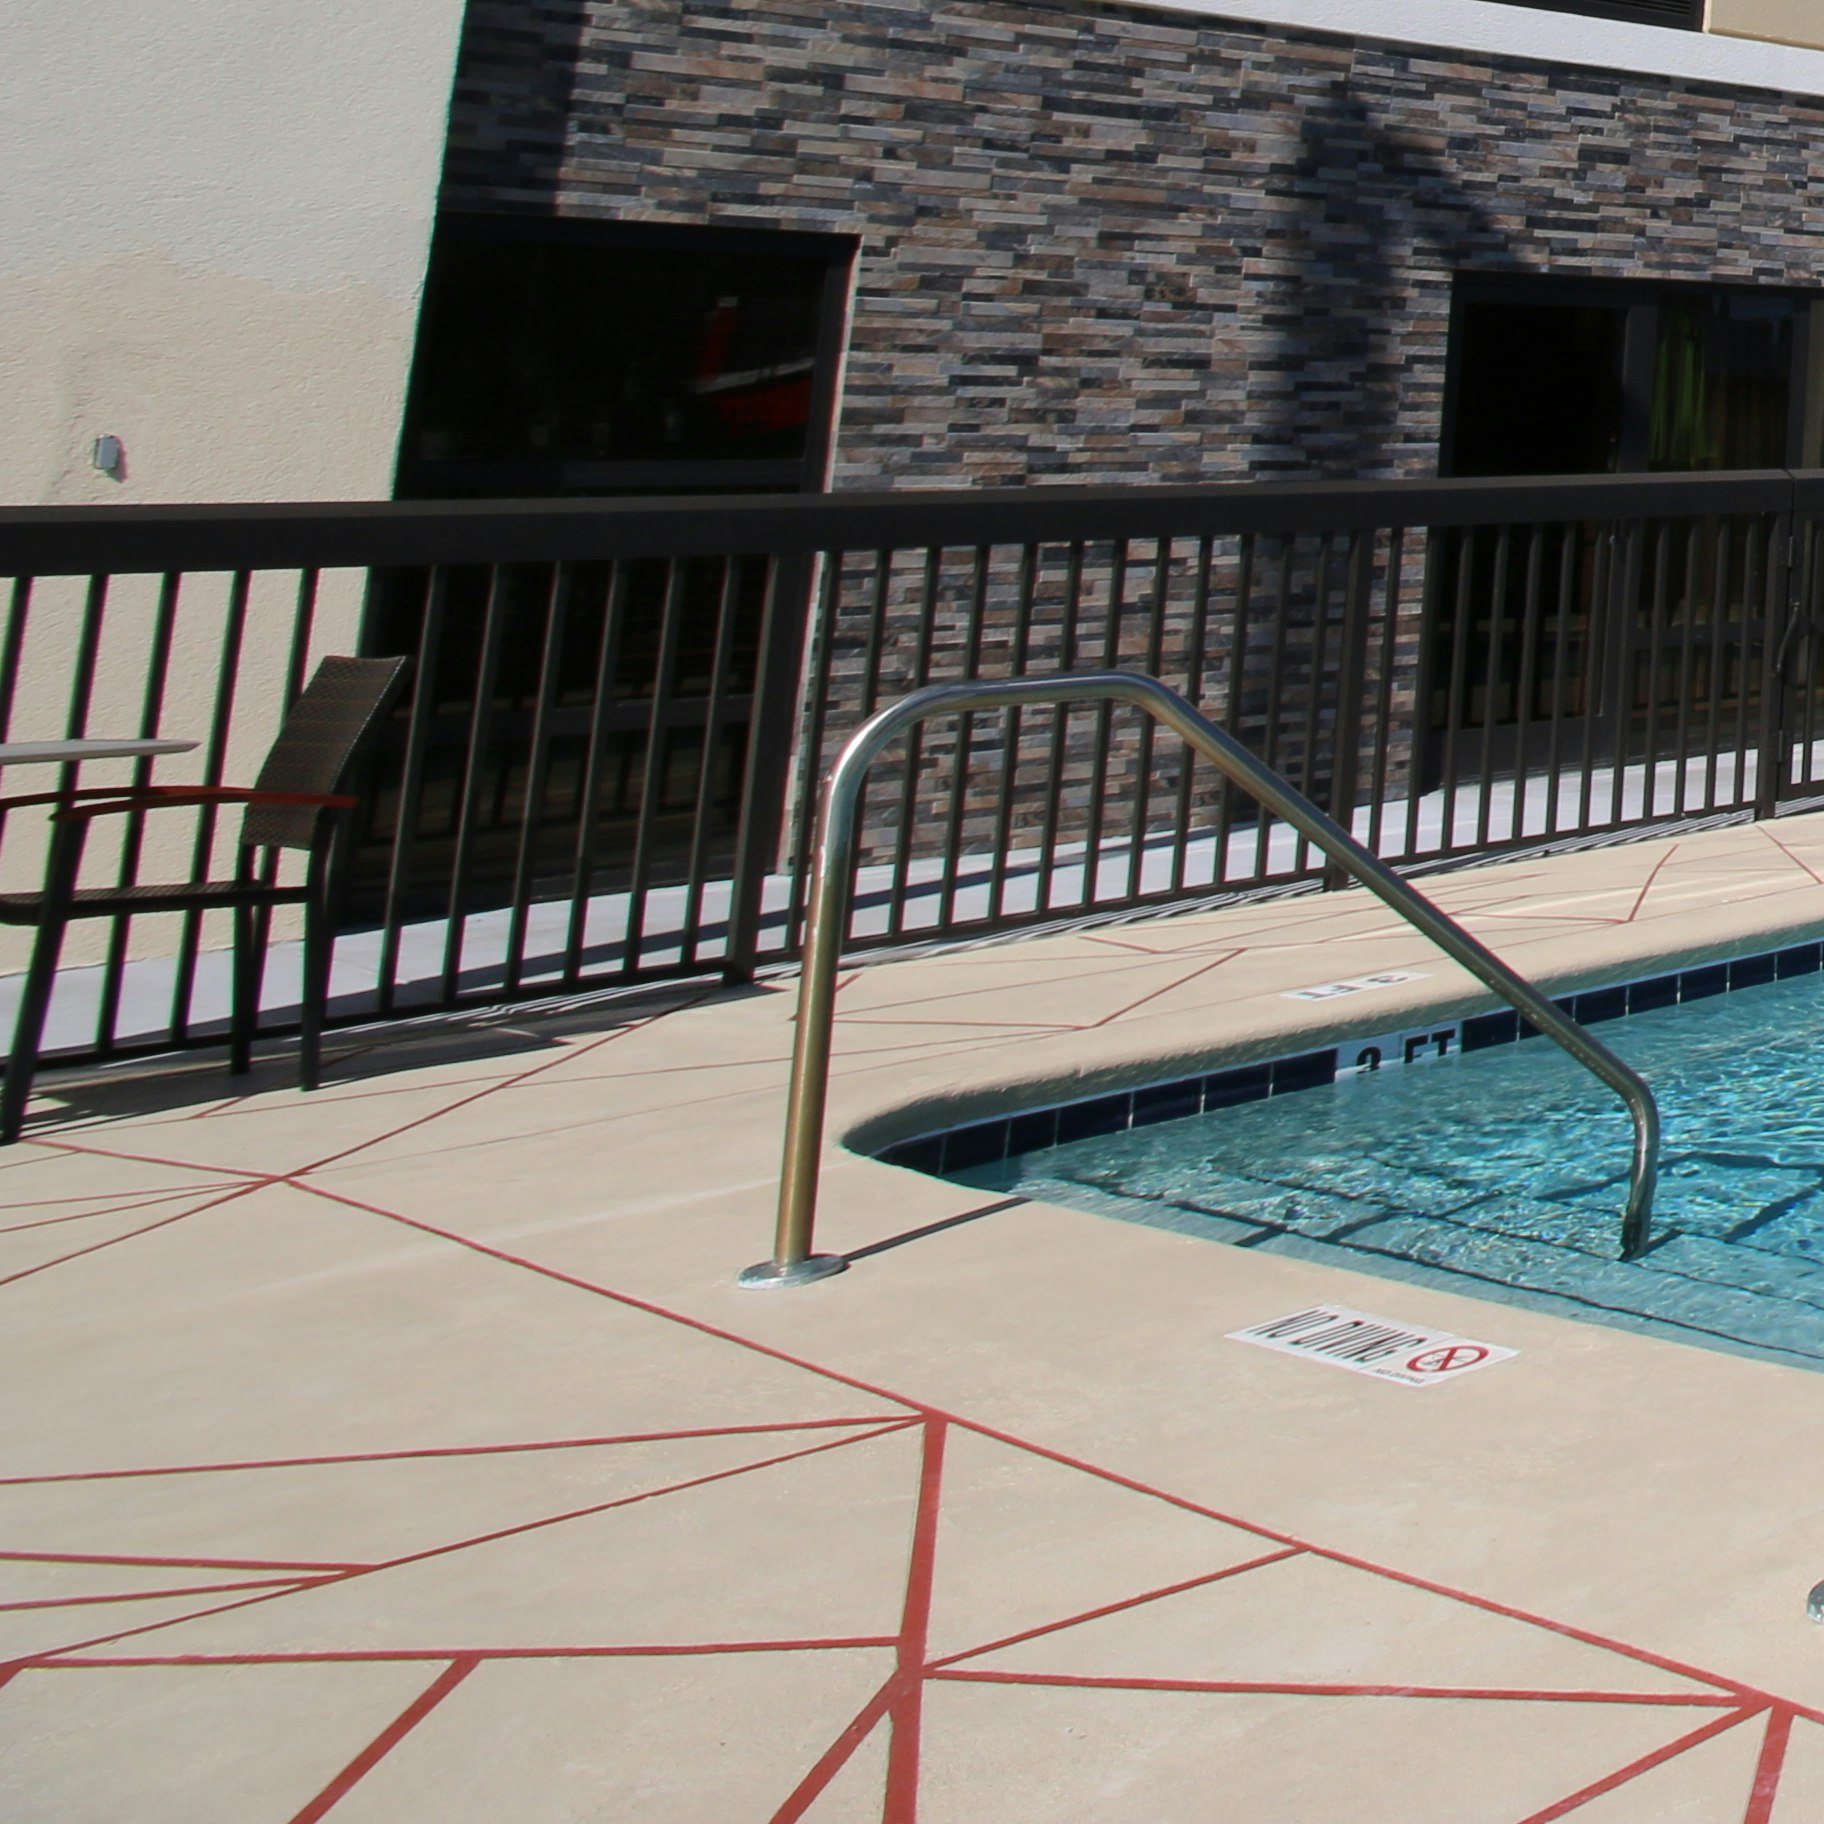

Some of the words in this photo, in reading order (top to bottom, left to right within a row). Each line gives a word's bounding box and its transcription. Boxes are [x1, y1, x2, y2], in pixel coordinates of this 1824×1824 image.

[1404, 1028, 1457, 1064] FT
[1246, 1310, 1340, 1339] NO
[1288, 1320, 1428, 1363] DIVING
